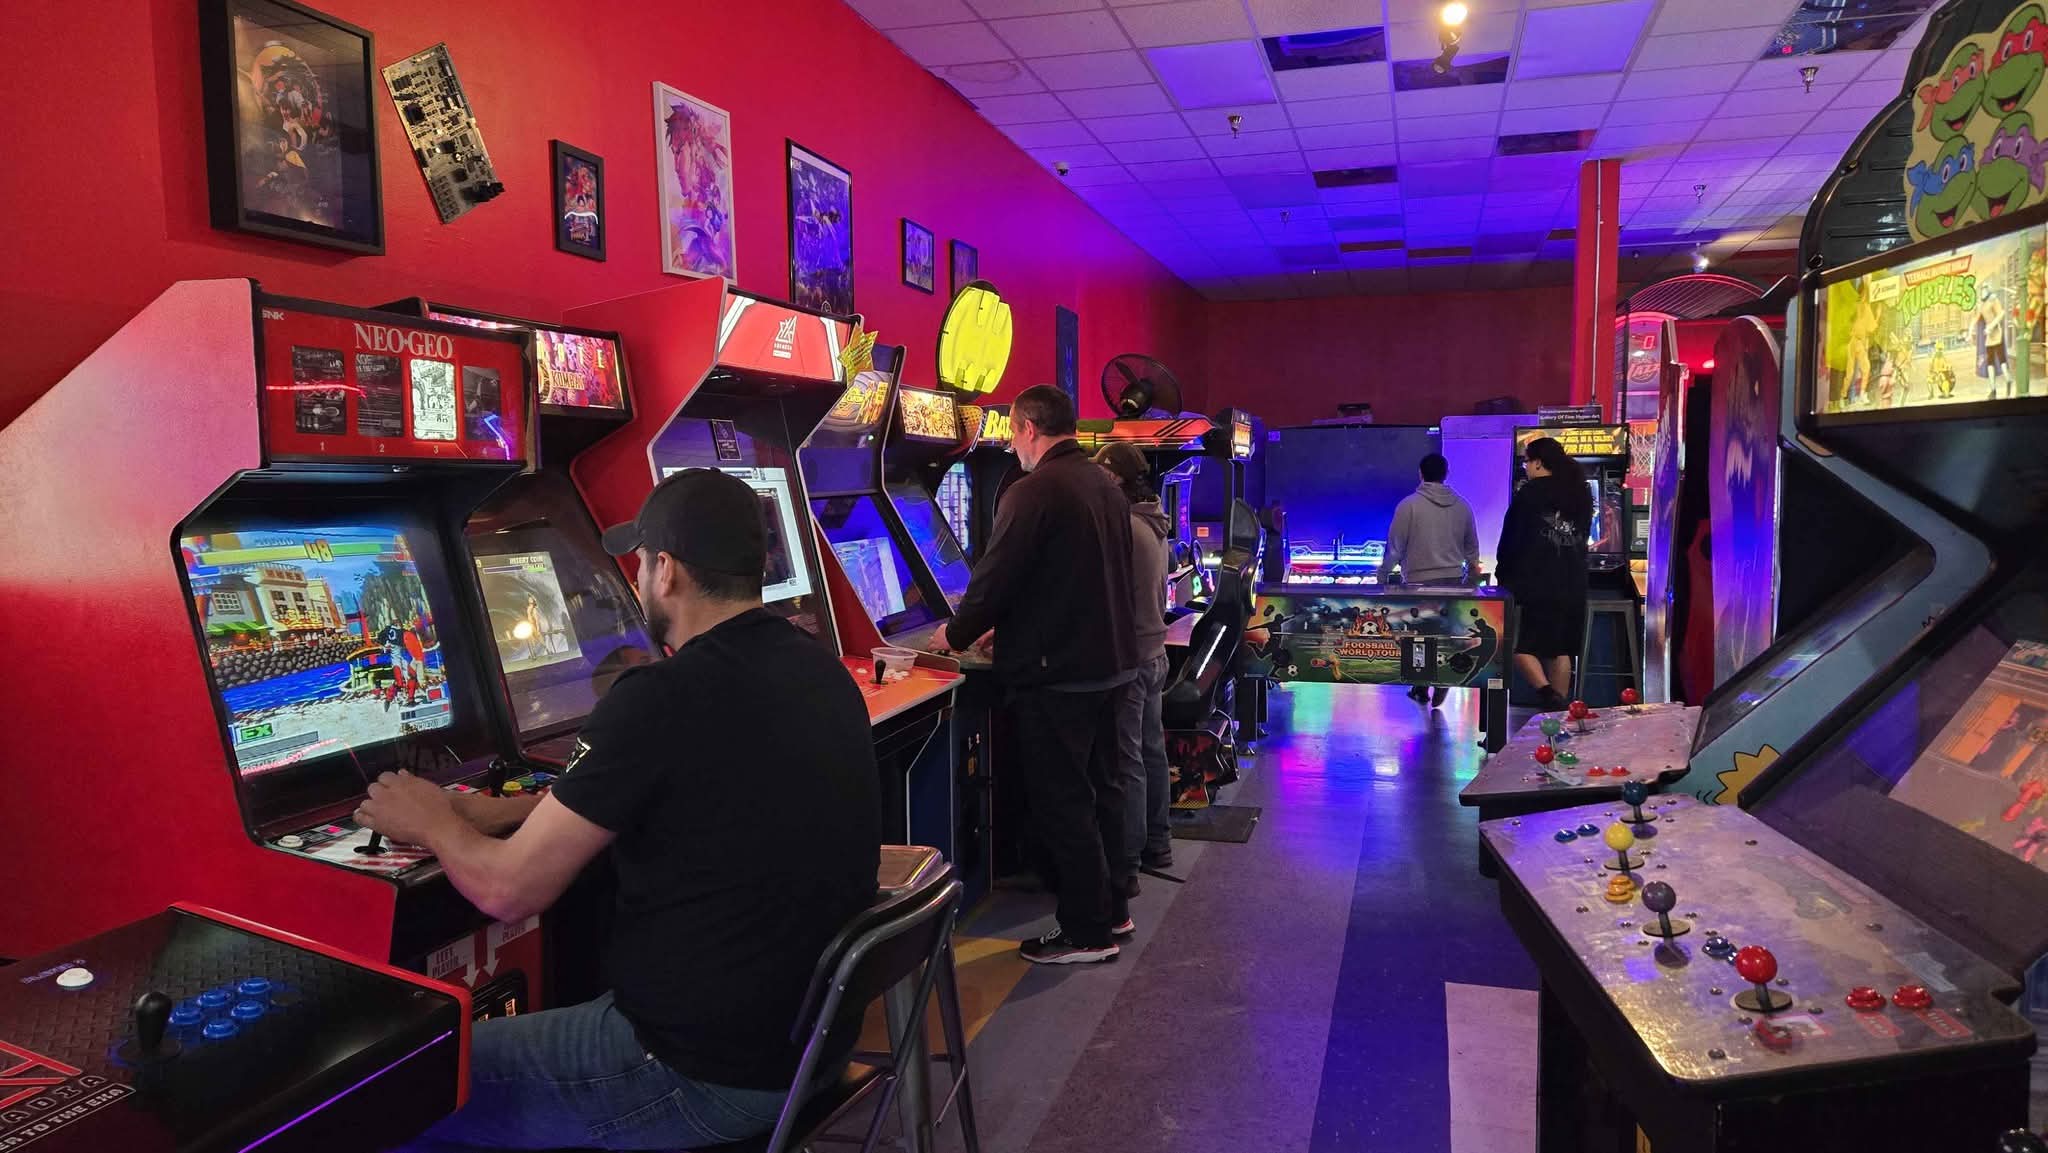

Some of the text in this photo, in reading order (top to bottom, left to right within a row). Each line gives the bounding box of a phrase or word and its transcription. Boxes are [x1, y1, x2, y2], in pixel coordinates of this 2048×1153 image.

[1896, 273, 1976, 327] TURTLES
[551, 370, 586, 391] KOMBAT
[319, 441, 326, 452] 1
[378, 443, 386, 454] 2
[432, 444, 440, 455] 3
[304, 539, 334, 563] 48
[1339, 648, 1374, 657] WORLD
[1345, 641, 1396, 649] FOOSBALL
[241, 723, 273, 742] EX
[432, 946, 454, 965] LEFT
[21, 1123, 50, 1138] TO
